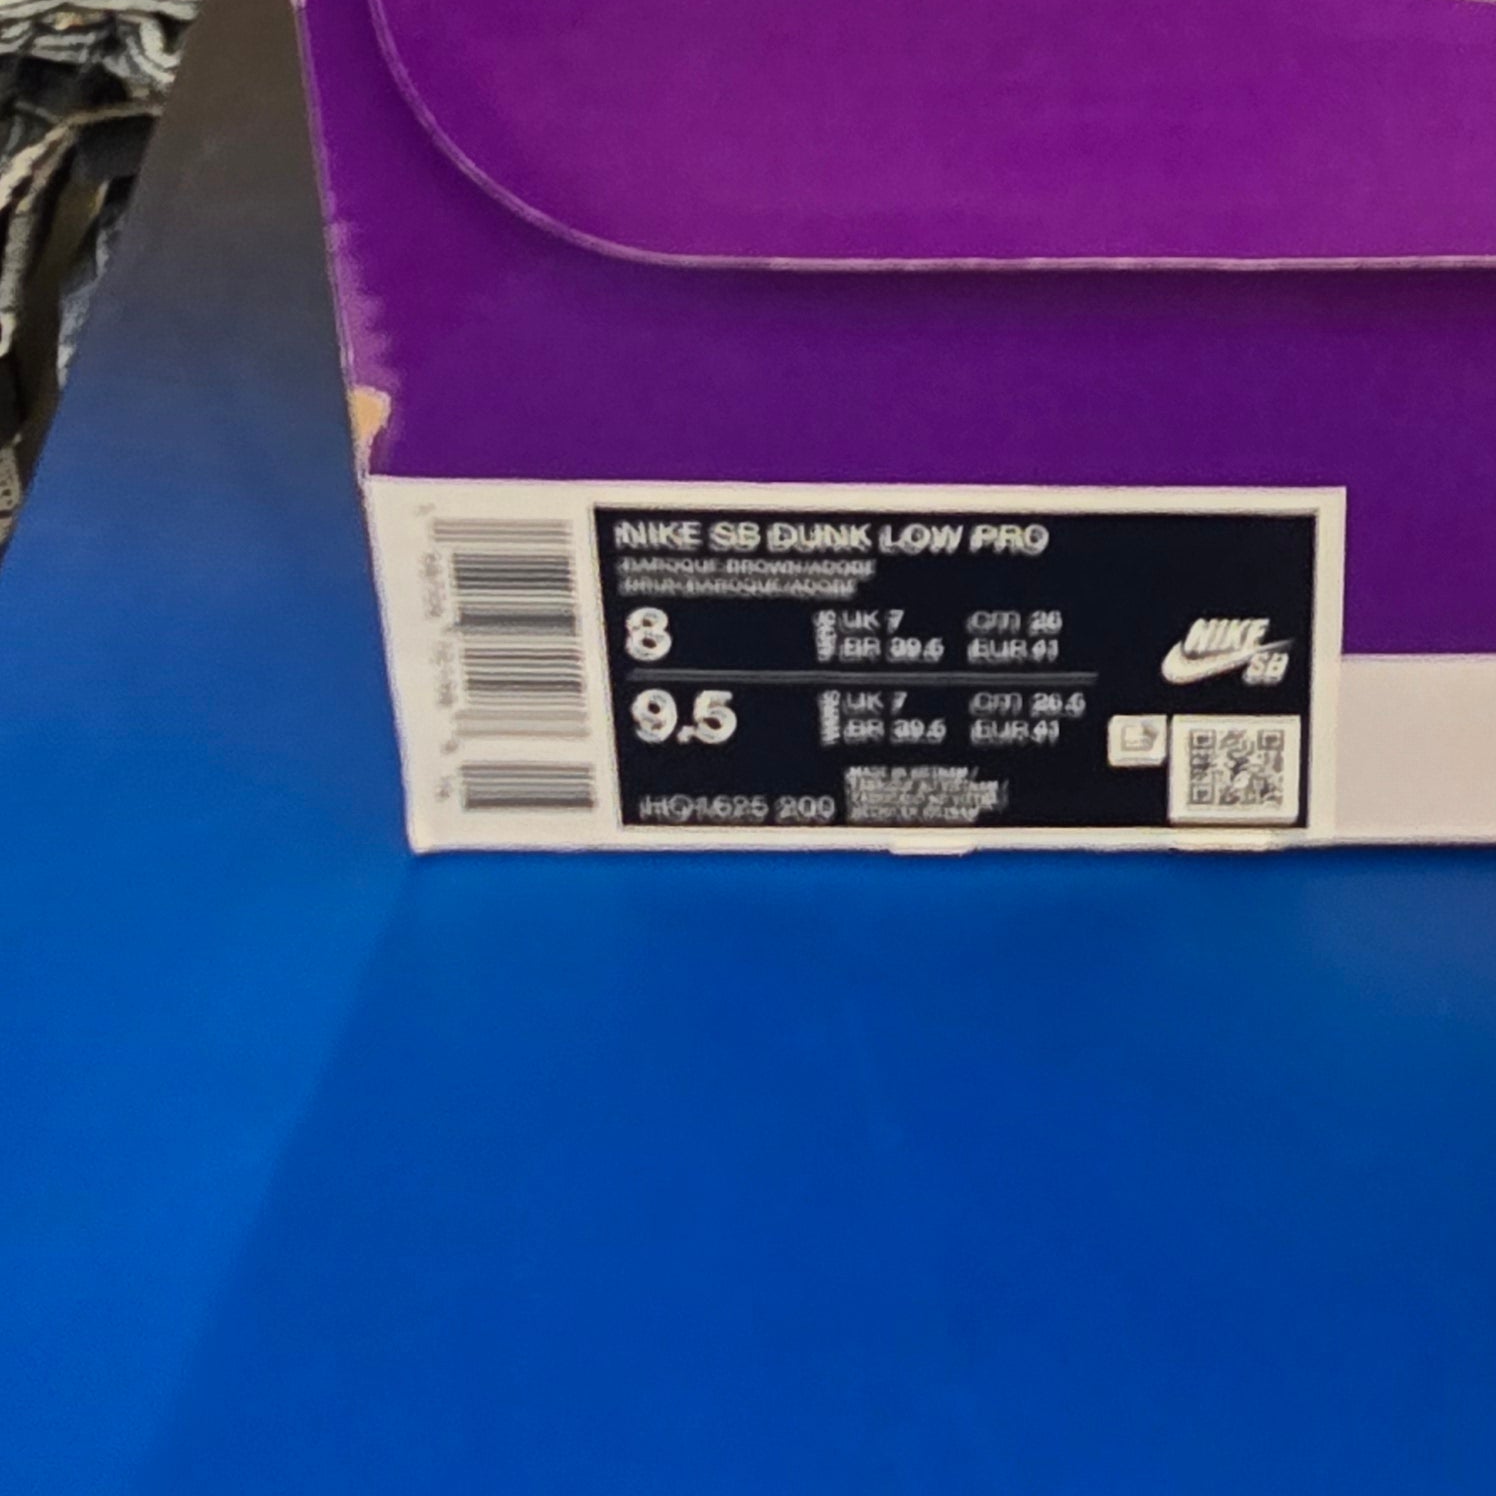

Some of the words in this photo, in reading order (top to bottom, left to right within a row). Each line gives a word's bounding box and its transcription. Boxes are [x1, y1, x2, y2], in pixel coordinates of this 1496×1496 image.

[614, 519, 702, 552] NIKE
[708, 520, 762, 553] SB
[766, 521, 873, 554] DUNK
[878, 522, 965, 555] LOW
[968, 522, 1050, 556] PRO
[624, 606, 673, 662] 8
[839, 609, 882, 632] UK
[886, 608, 905, 634] 7
[1027, 609, 1064, 636] 26
[838, 636, 883, 663] BR
[966, 637, 1028, 664] EUR
[1031, 637, 1060, 663] 41
[1183, 617, 1271, 656] NIKE
[1241, 652, 1290, 686] SB
[630, 688, 739, 746] 9.5
[842, 690, 885, 716] UK
[889, 690, 908, 716] 7
[842, 718, 886, 745] BR
[969, 718, 1030, 746] EUR
[1031, 718, 1061, 745] 41
[775, 795, 837, 825] 200
